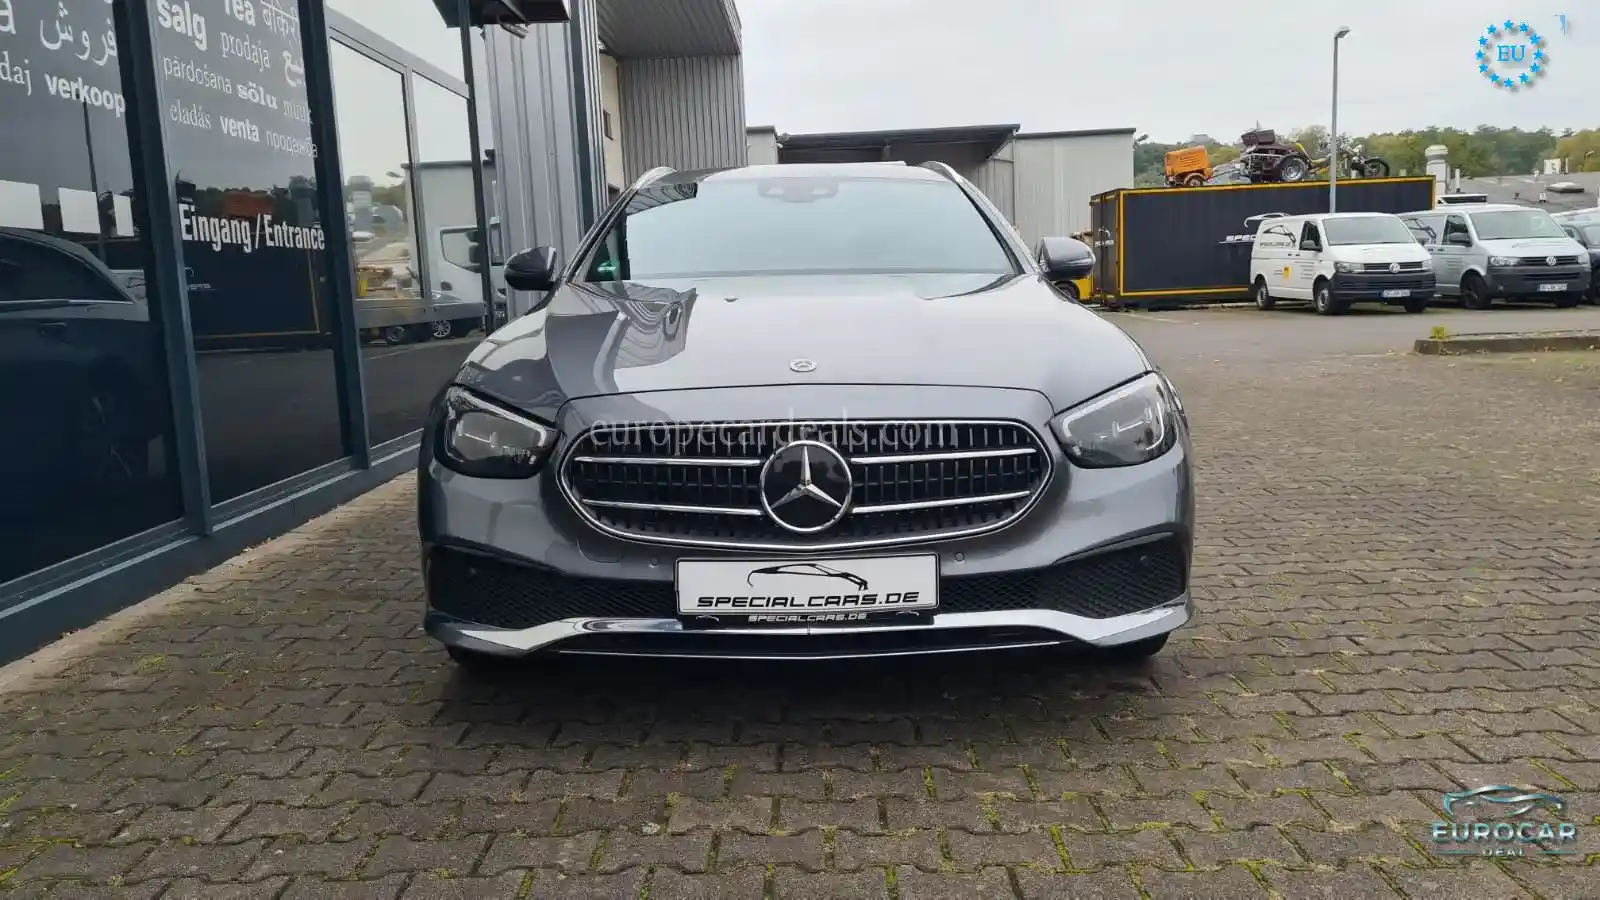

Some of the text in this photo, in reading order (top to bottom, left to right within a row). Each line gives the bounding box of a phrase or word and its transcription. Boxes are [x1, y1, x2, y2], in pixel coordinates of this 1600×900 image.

[156, 0, 207, 51] salg
[220, 31, 272, 72] prodaja
[44, 72, 125, 118] verkoop
[170, 99, 212, 129] eladás
[220, 115, 260, 142] venta
[697, 591, 920, 608] SPECIALCARS.DE
